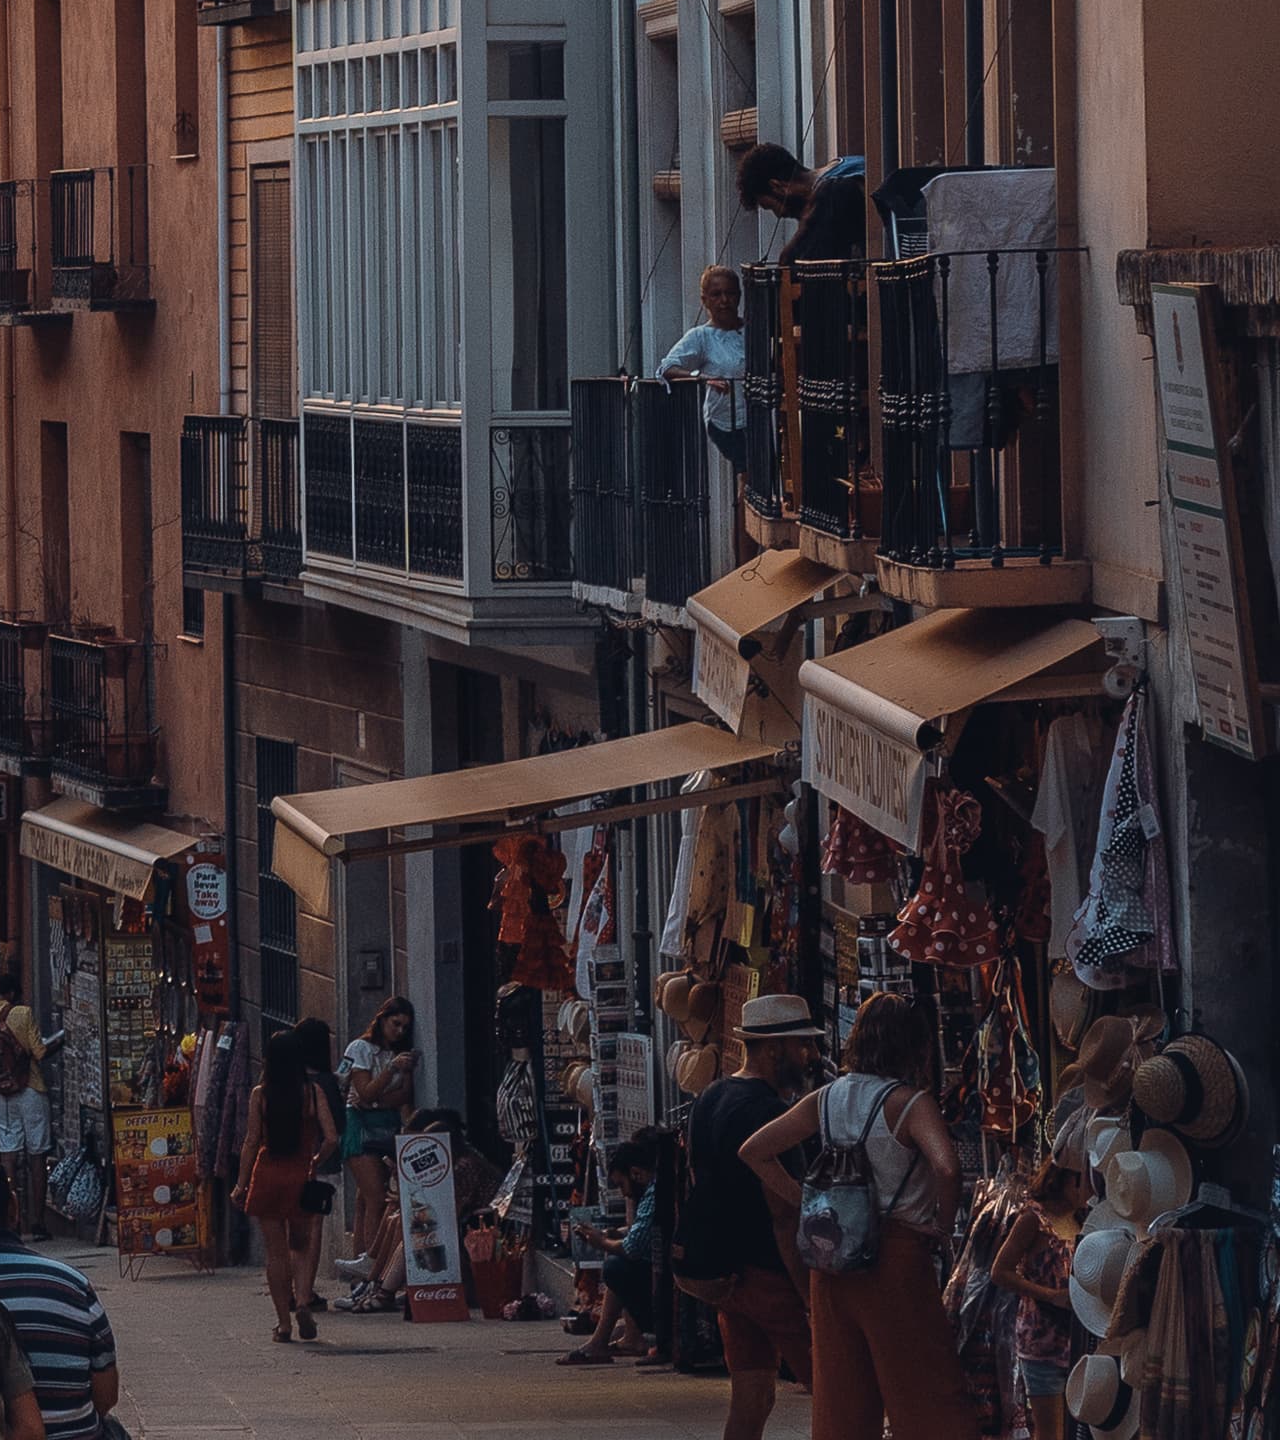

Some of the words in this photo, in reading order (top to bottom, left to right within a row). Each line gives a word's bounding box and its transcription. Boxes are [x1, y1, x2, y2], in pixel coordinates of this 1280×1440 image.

[196, 872, 216, 880] Para
[194, 889, 218, 898] Take
[193, 899, 220, 908] away
[125, 1115, 160, 1127] OFERTA
